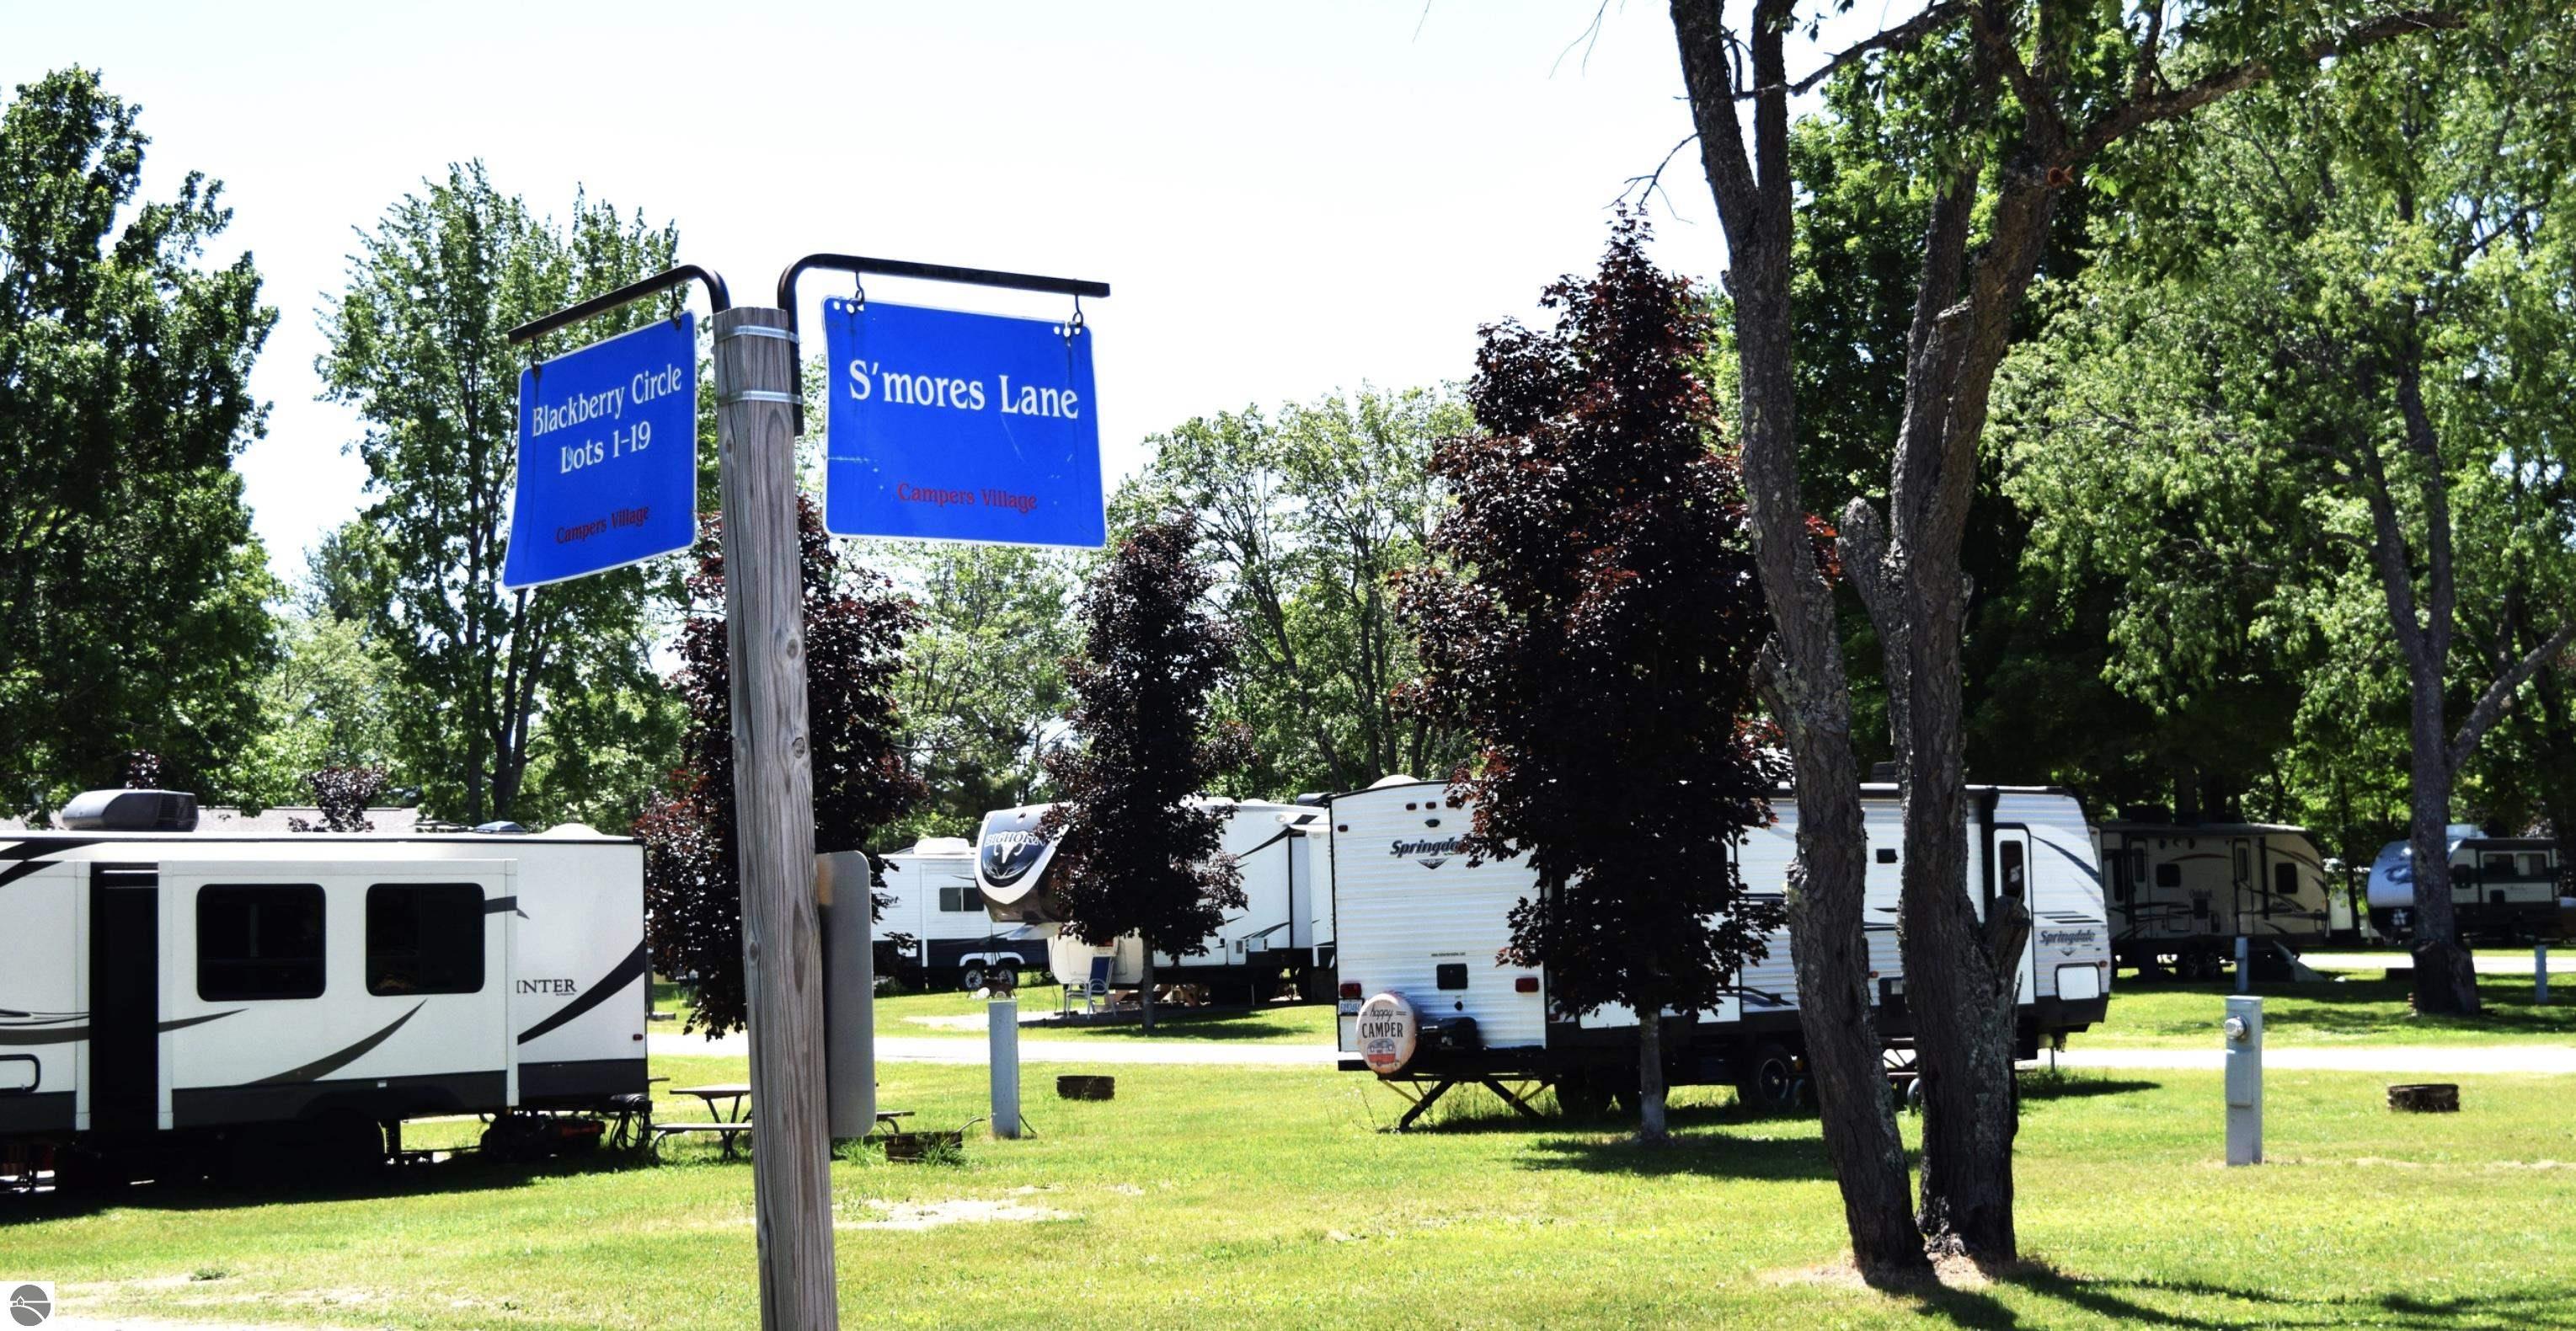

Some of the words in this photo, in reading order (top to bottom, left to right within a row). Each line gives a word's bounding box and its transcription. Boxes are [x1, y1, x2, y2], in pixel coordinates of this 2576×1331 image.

[532, 386, 625, 438] Blackberry
[632, 363, 682, 405] Circle
[848, 359, 986, 411] S'mores
[998, 374, 1079, 420] Lane
[560, 439, 604, 474] Lots
[612, 420, 651, 458] 1-19
[897, 483, 975, 507] Campers
[981, 489, 1038, 514] Village
[556, 518, 607, 544] Campers
[611, 505, 650, 528] Village
[1389, 837, 1461, 858] Springda
[2039, 929, 2096, 946] Springdale
[1370, 1004, 1394, 1022] happy
[1362, 1022, 1403, 1039] CAMPER
